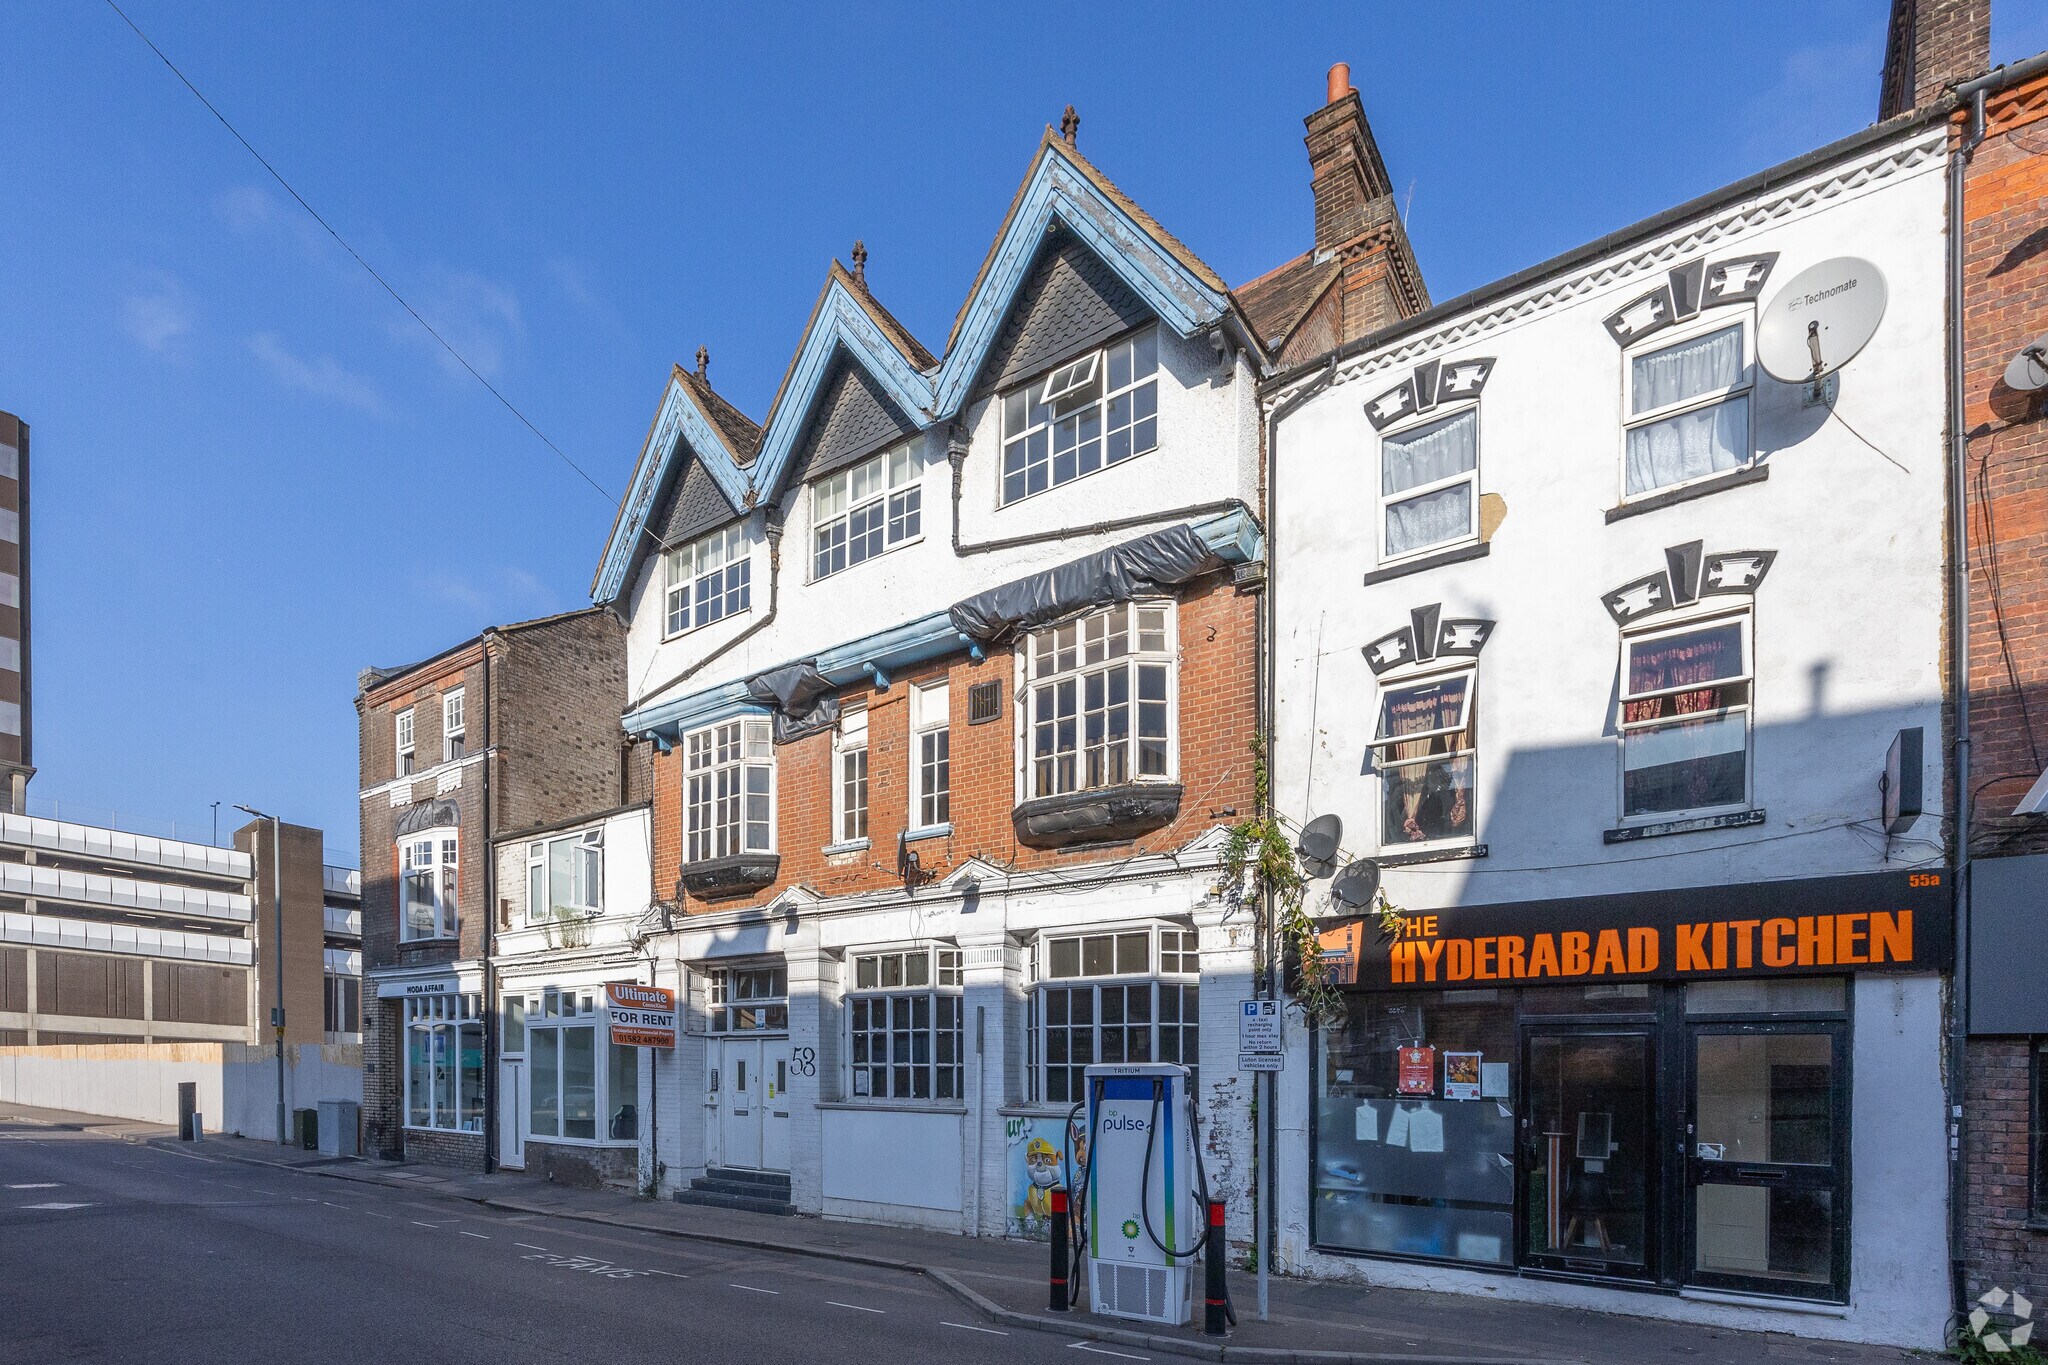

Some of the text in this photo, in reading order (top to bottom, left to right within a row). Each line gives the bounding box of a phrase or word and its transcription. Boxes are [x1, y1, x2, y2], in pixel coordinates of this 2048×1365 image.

[1804, 279, 1857, 306] Technomate
[1909, 874, 1940, 887] 55a
[1391, 910, 1913, 983] HYDERABAD KITCHEN
[406, 984, 445, 994] MODA AFFAIR
[615, 985, 667, 1003] Ultimate
[611, 1011, 673, 1026] FOR RENT
[618, 1034, 669, 1045] 01582 487900
[1108, 1109, 1118, 1117] bp
[1103, 1114, 1145, 1134] pulse
